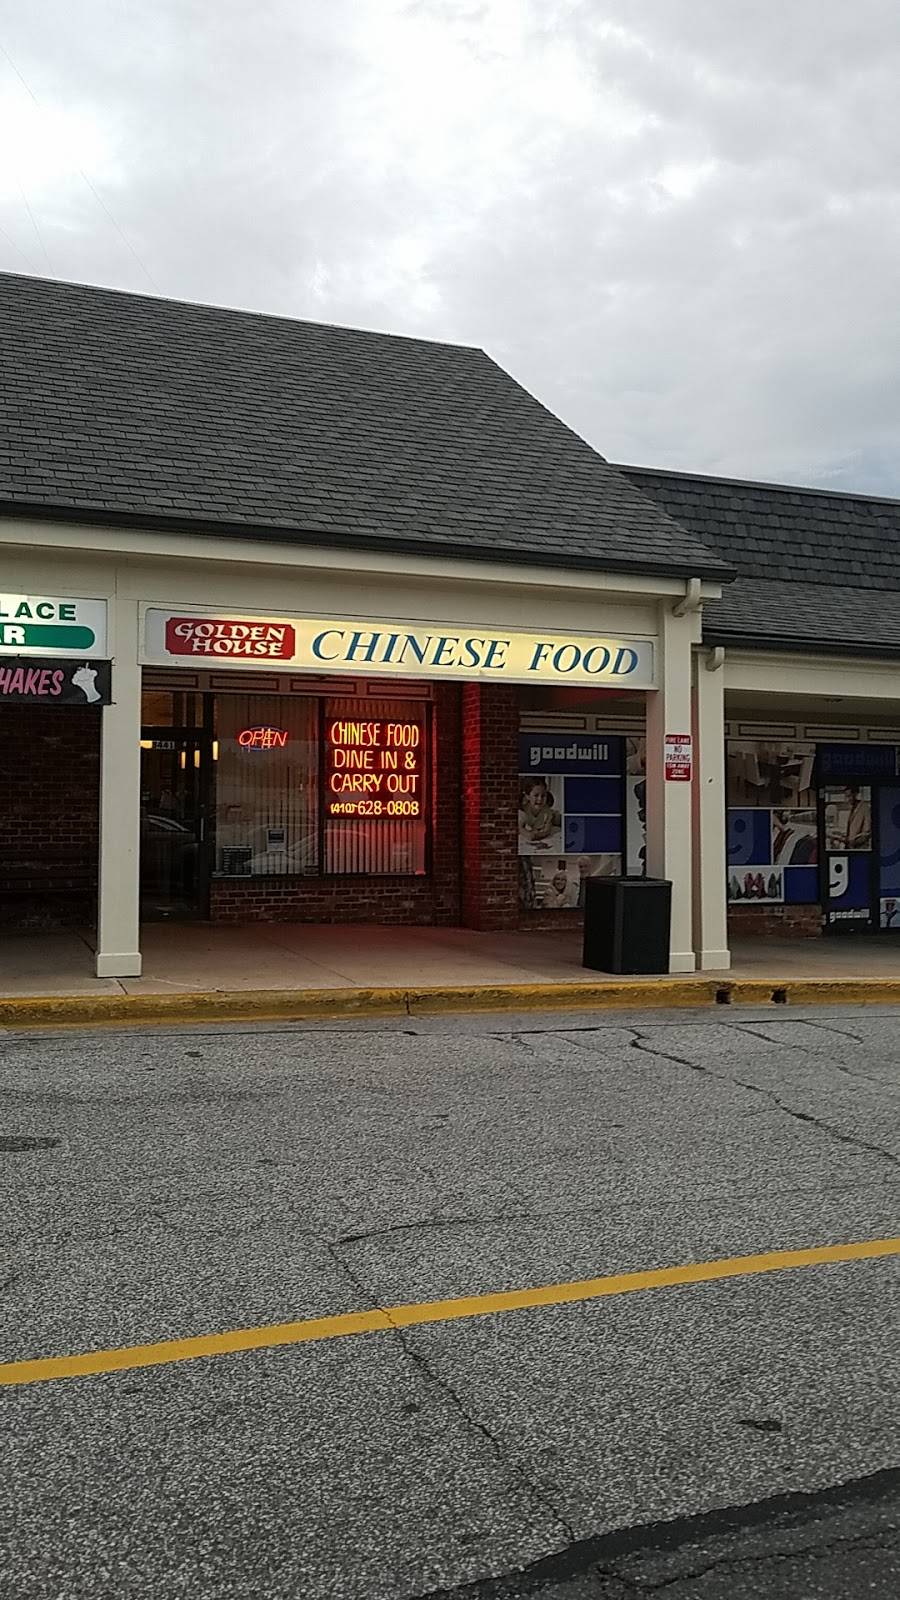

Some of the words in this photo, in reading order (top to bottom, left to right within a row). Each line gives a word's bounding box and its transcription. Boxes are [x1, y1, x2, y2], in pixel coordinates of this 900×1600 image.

[174, 622, 285, 643] GOLDEN
[191, 638, 284, 656] HOUSE
[311, 629, 511, 670] CHINESE
[528, 642, 640, 676] FOOD
[238, 728, 288, 748] OPEN
[331, 721, 381, 747] CHINESE
[386, 723, 419, 748] FOOD
[334, 749, 374, 769] DINE
[381, 751, 398, 769] IN
[404, 751, 417, 770] &
[530, 744, 609, 765] goodwill
[331, 773, 383, 793] CARRY
[387, 774, 419, 793] OUT
[829, 908, 870, 922] goodwill
